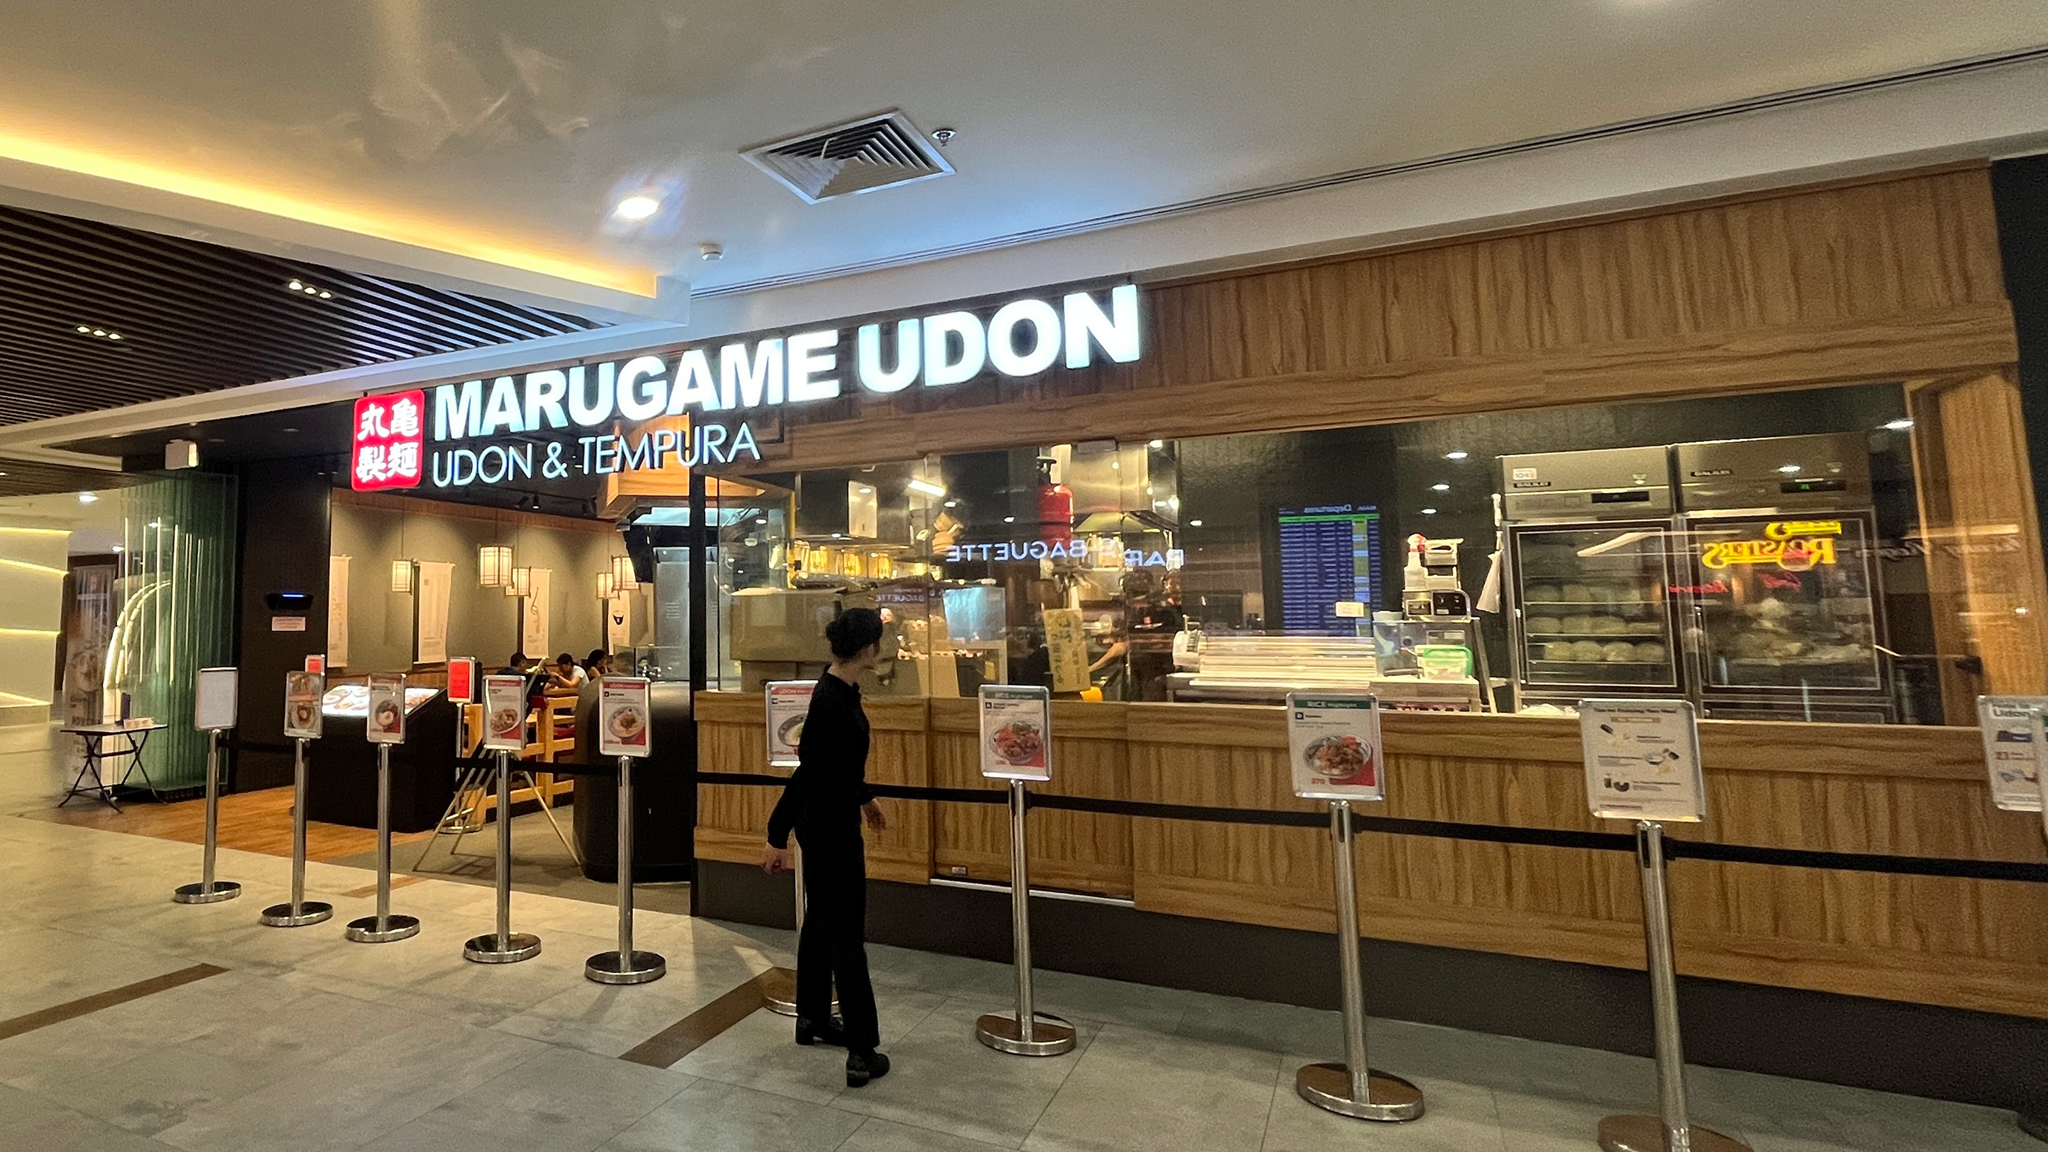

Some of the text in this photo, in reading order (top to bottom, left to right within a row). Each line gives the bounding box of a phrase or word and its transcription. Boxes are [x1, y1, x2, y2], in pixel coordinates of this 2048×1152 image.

[433, 283, 1142, 442] MARUGAME UDON
[356, 397, 420, 442] 丸亀
[432, 421, 761, 488] UDON & TEMPURA
